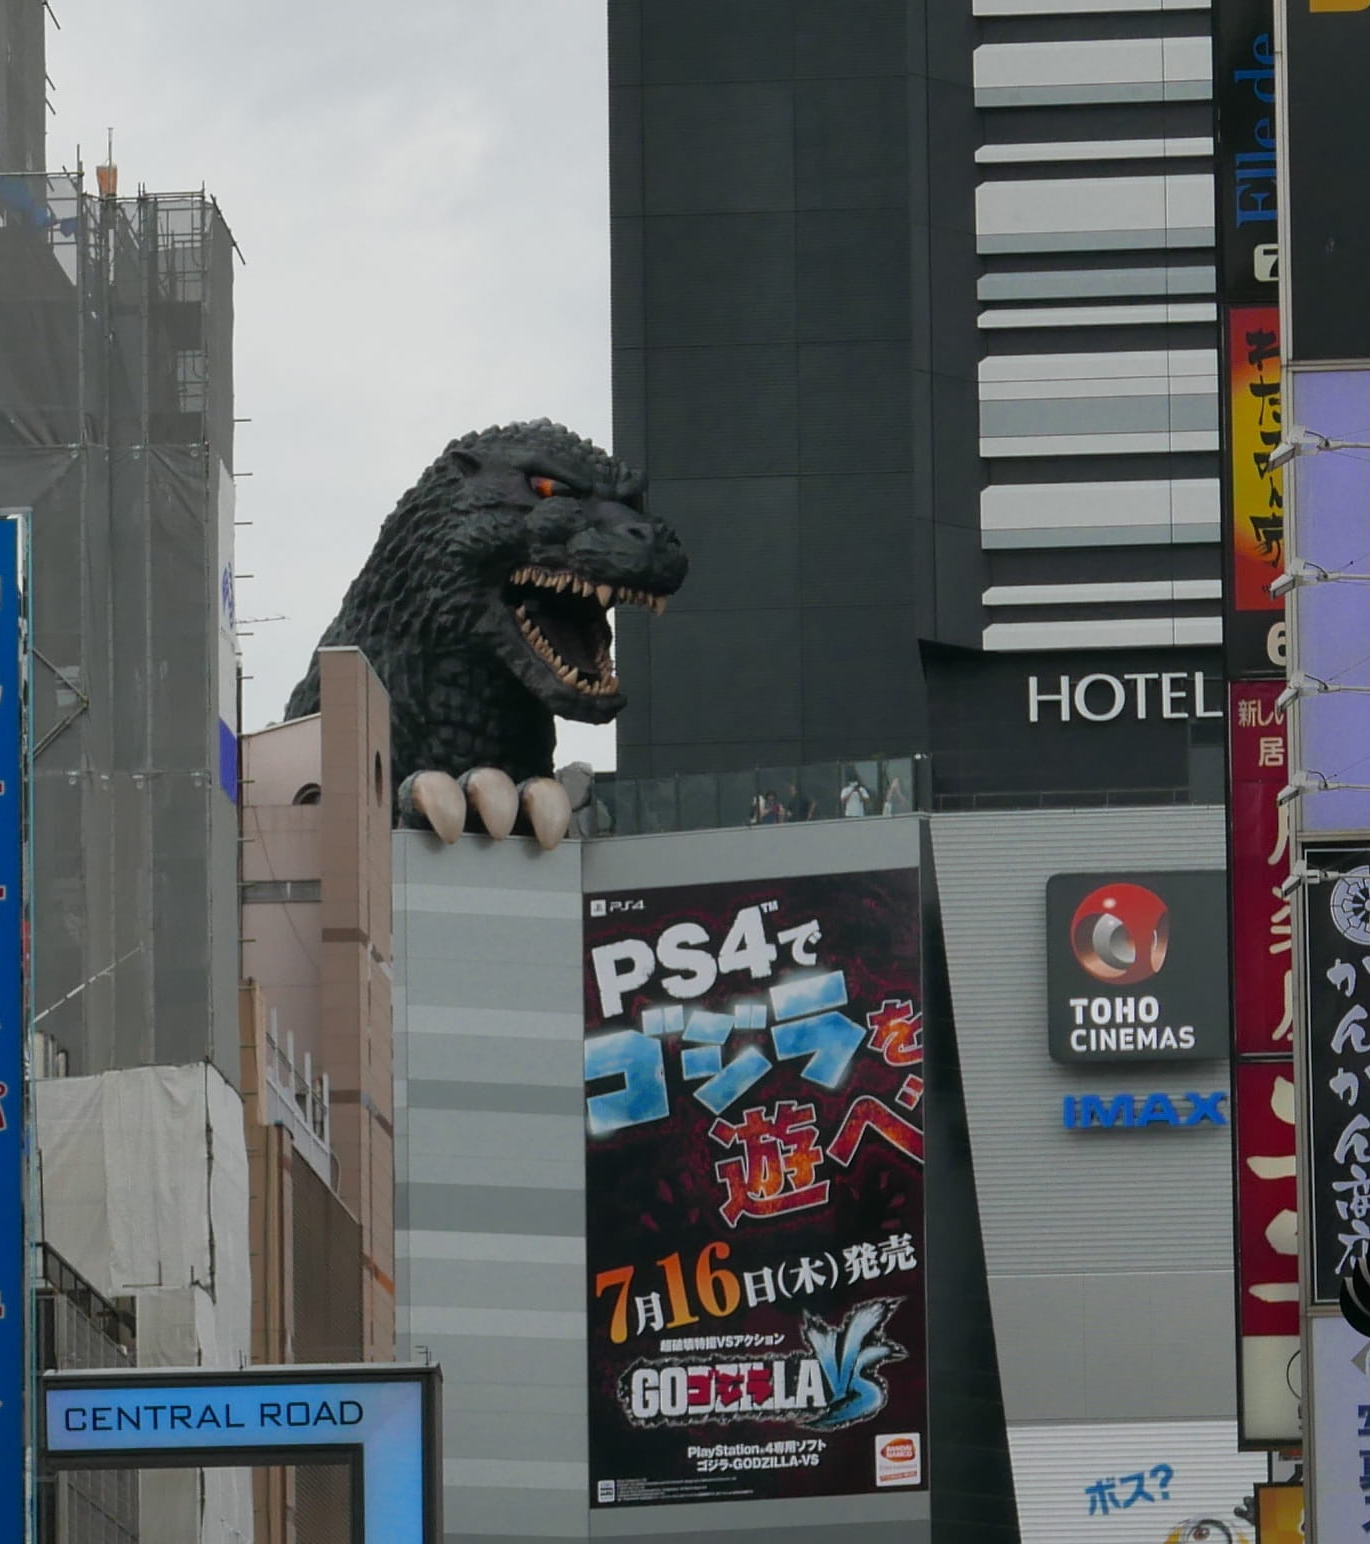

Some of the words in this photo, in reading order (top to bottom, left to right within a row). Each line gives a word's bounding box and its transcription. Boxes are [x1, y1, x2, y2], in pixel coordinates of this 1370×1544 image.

[1029, 671, 1224, 724] HOTEL
[1070, 997, 1160, 1026] TOHO
[1070, 1025, 1196, 1053] CINEMAS
[1062, 1091, 1228, 1130] IMAX
[708, 1074, 925, 1228] 遊べ
[64, 1401, 245, 1432] CENTRAL
[259, 1400, 364, 1428] ROAD
